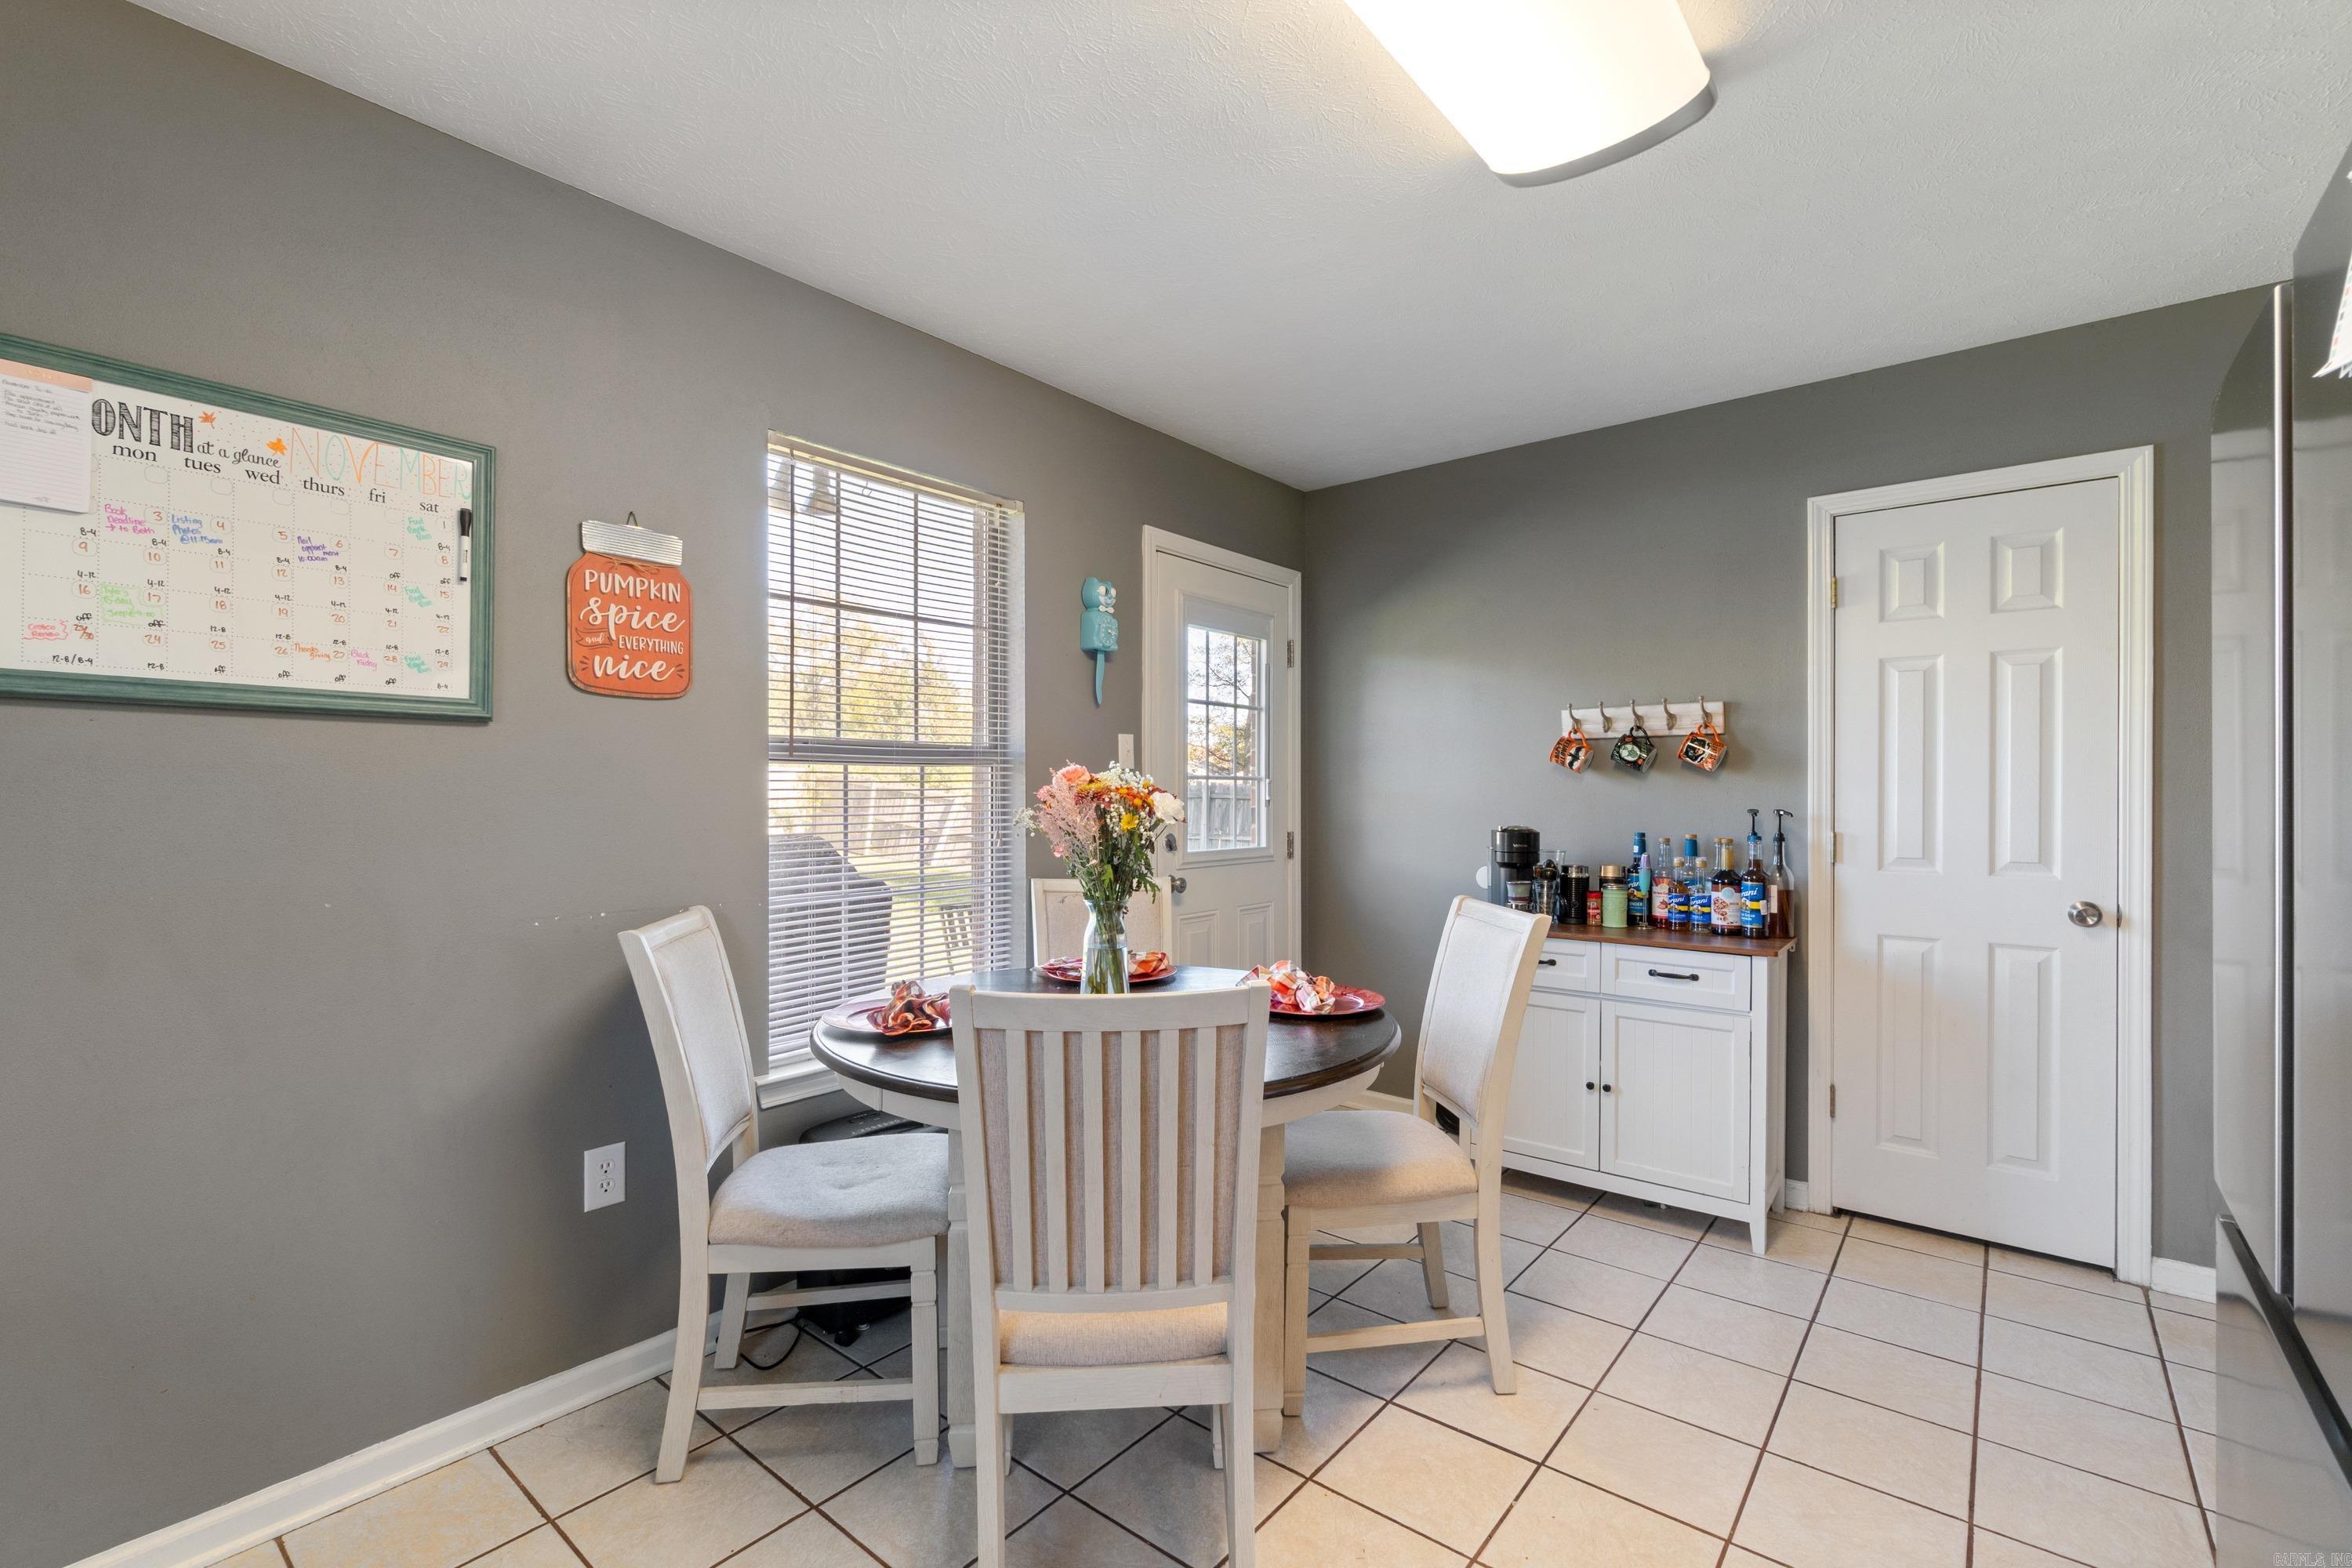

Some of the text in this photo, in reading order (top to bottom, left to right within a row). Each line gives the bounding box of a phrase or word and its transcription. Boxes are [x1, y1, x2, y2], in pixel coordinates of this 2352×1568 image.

[92, 398, 194, 453] ONTH
[113, 445, 157, 462] mon
[197, 441, 281, 468] at a glance
[184, 457, 221, 473] tues
[290, 427, 472, 500] NOVEMBER
[245, 470, 280, 485] wed
[303, 477, 345, 496] thurs
[369, 488, 386, 503] fri
[419, 502, 439, 513] sat
[153, 511, 163, 521] 3
[216, 521, 226, 530] 4
[80, 527, 96, 537] 8-4
[278, 532, 288, 540] 5
[78, 542, 88, 552] 9
[336, 540, 343, 549] 6
[438, 543, 450, 551] 8-4
[148, 552, 161, 561] 10
[389, 548, 398, 557] 7
[441, 556, 448, 564] 8
[334, 576, 345, 585] 13
[79, 584, 91, 594] 16
[584, 569, 681, 603] PUMPKIN
[148, 592, 161, 602] 17
[216, 601, 227, 610] 18
[278, 608, 289, 617] 19
[331, 614, 345, 622] 20
[148, 619, 165, 628] off
[144, 634, 161, 644] 24
[586, 633, 684, 655] and EVERYTHING
[211, 641, 226, 649] 25
[593, 655, 675, 681] nice
